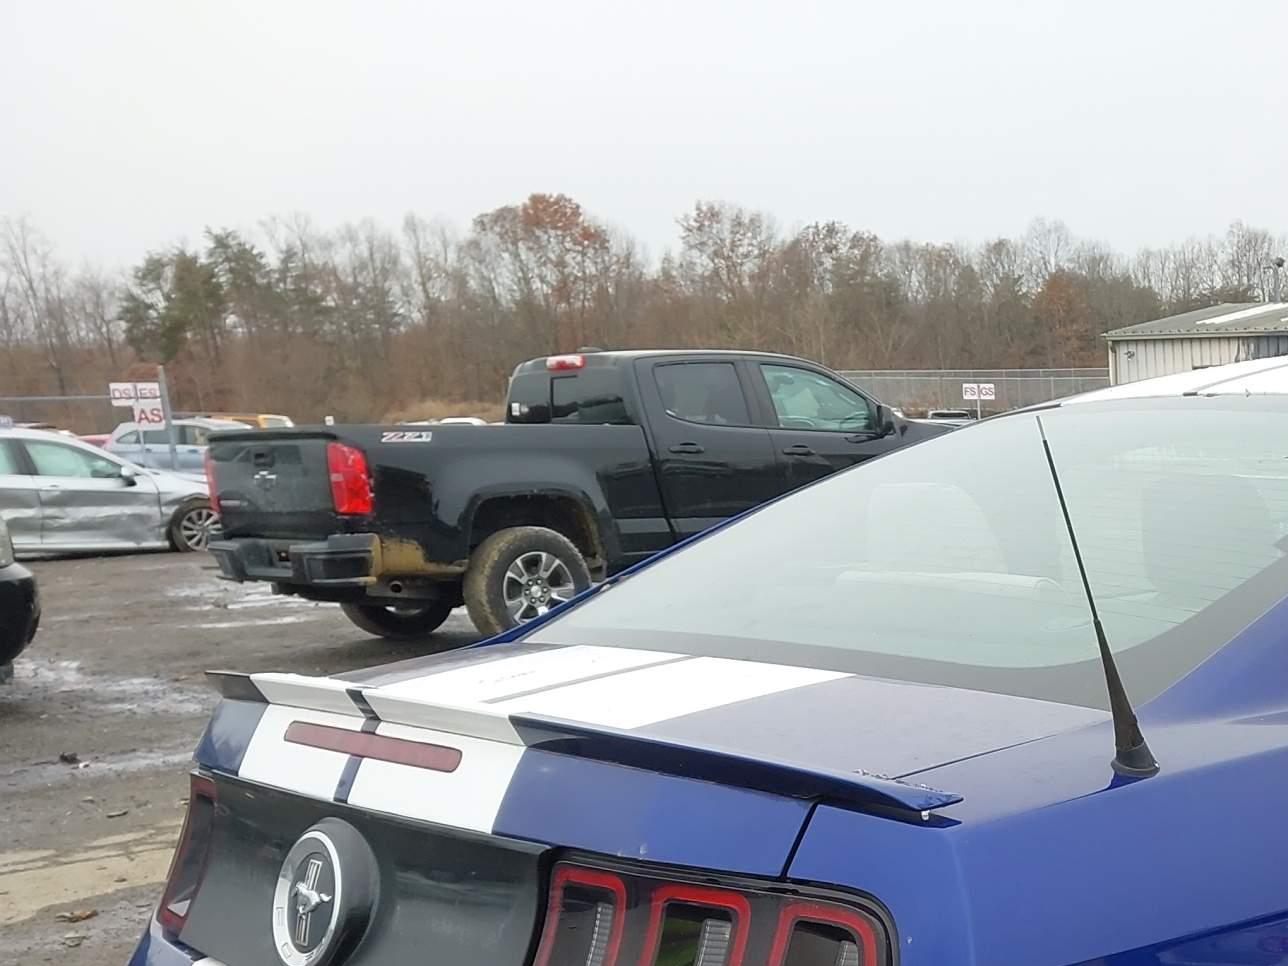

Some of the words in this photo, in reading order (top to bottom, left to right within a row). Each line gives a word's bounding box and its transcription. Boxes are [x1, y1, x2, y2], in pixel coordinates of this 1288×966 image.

[964, 387, 976, 397] FS
[980, 386, 994, 396] GS
[138, 408, 162, 423] AS
